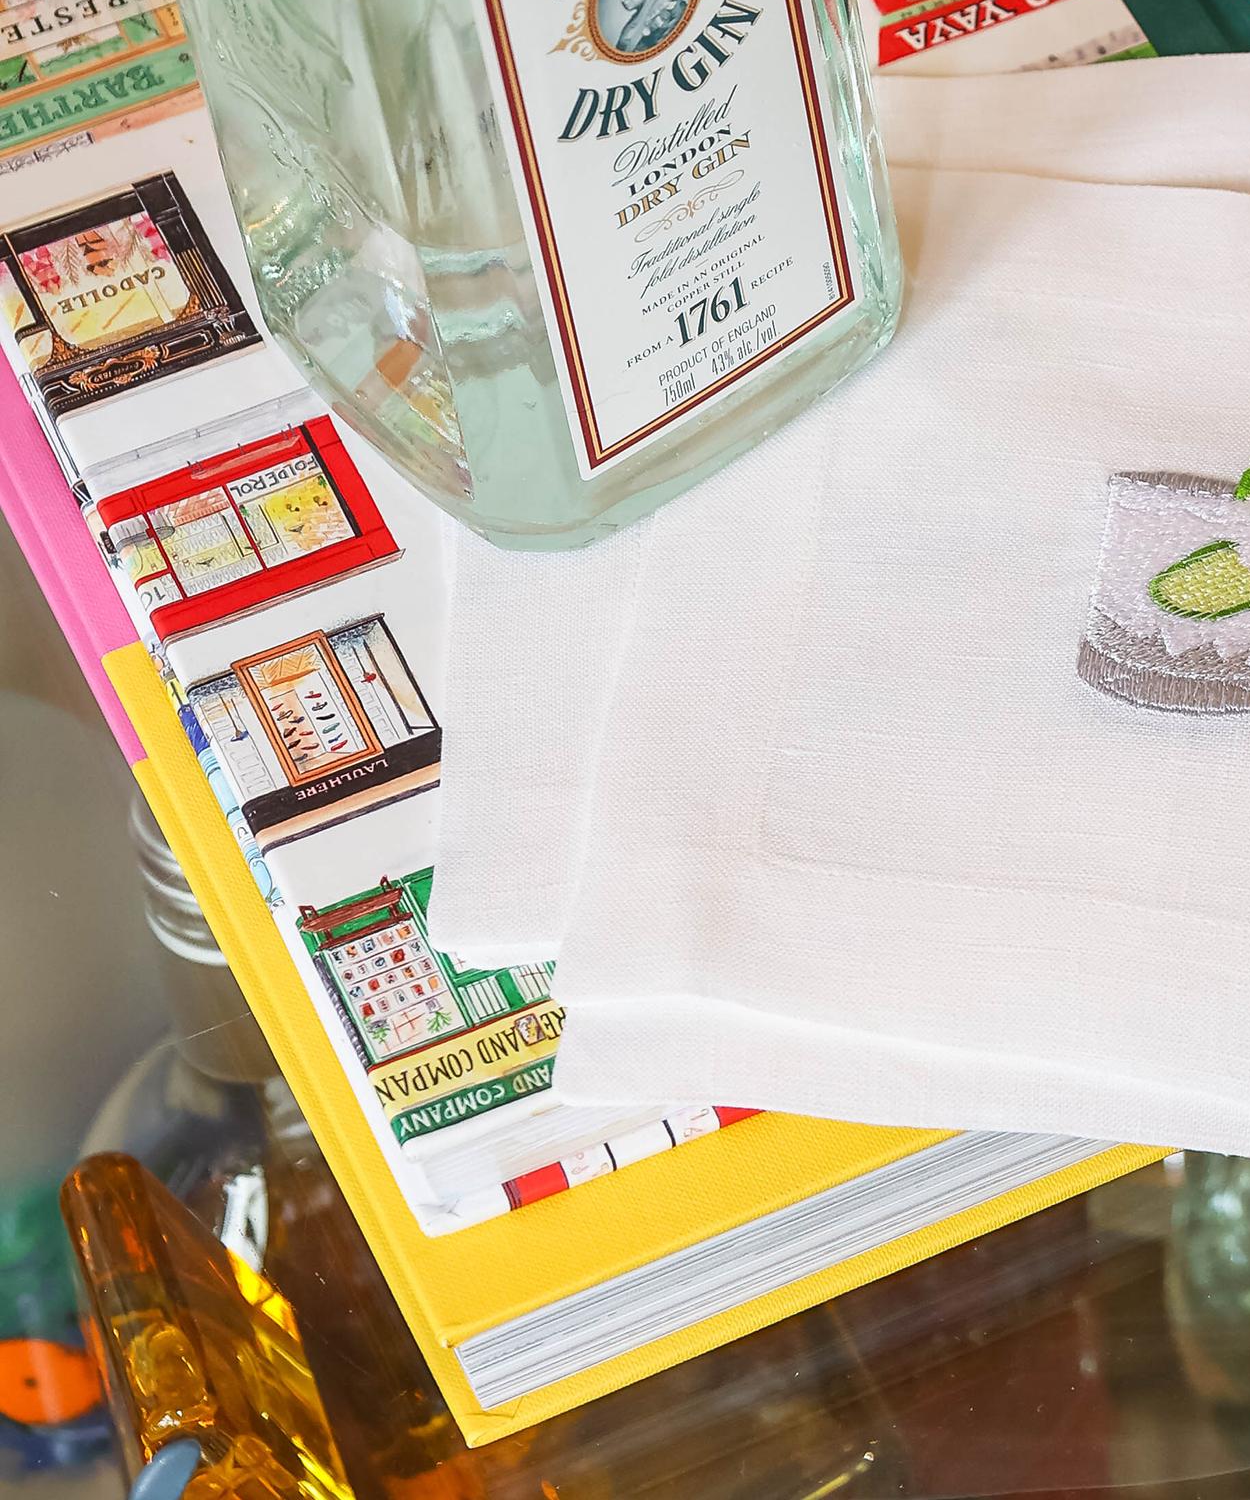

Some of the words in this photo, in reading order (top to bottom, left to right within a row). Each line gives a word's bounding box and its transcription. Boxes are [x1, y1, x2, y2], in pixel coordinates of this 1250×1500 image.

[0, 63, 166, 141] BARTHE
[557, 67, 665, 142] DRY
[611, 84, 738, 187] Distilled
[614, 174, 683, 229] DRY
[691, 129, 751, 180] GIN
[627, 123, 732, 197] LONDON
[627, 207, 720, 280] Traditional
[717, 181, 761, 227] single
[640, 257, 680, 299] fold
[678, 214, 757, 270] distillation
[57, 265, 167, 315] CADOLLE
[641, 288, 675, 316] MADE
[677, 280, 691, 295] IN
[693, 270, 708, 287] AN
[711, 233, 766, 273] ORIGINAL
[667, 281, 711, 313] COPPER
[713, 260, 745, 286] STILL
[625, 342, 663, 369] FROM
[664, 334, 675, 347] A
[673, 275, 752, 348] 1761
[750, 256, 795, 290] RECIPE
[658, 346, 709, 387] PRODUCT
[711, 336, 725, 354] OF
[727, 303, 777, 345] ENGLAND
[662, 373, 697, 407] 750ml
[711, 348, 735, 376] 43%
[229, 454, 320, 499] FOLDEROL
[374, 1048, 475, 1108] COMPAN
[476, 1028, 521, 1065] AND
[512, 1063, 554, 1094] AND
[400, 1082, 507, 1137] COMPANY
